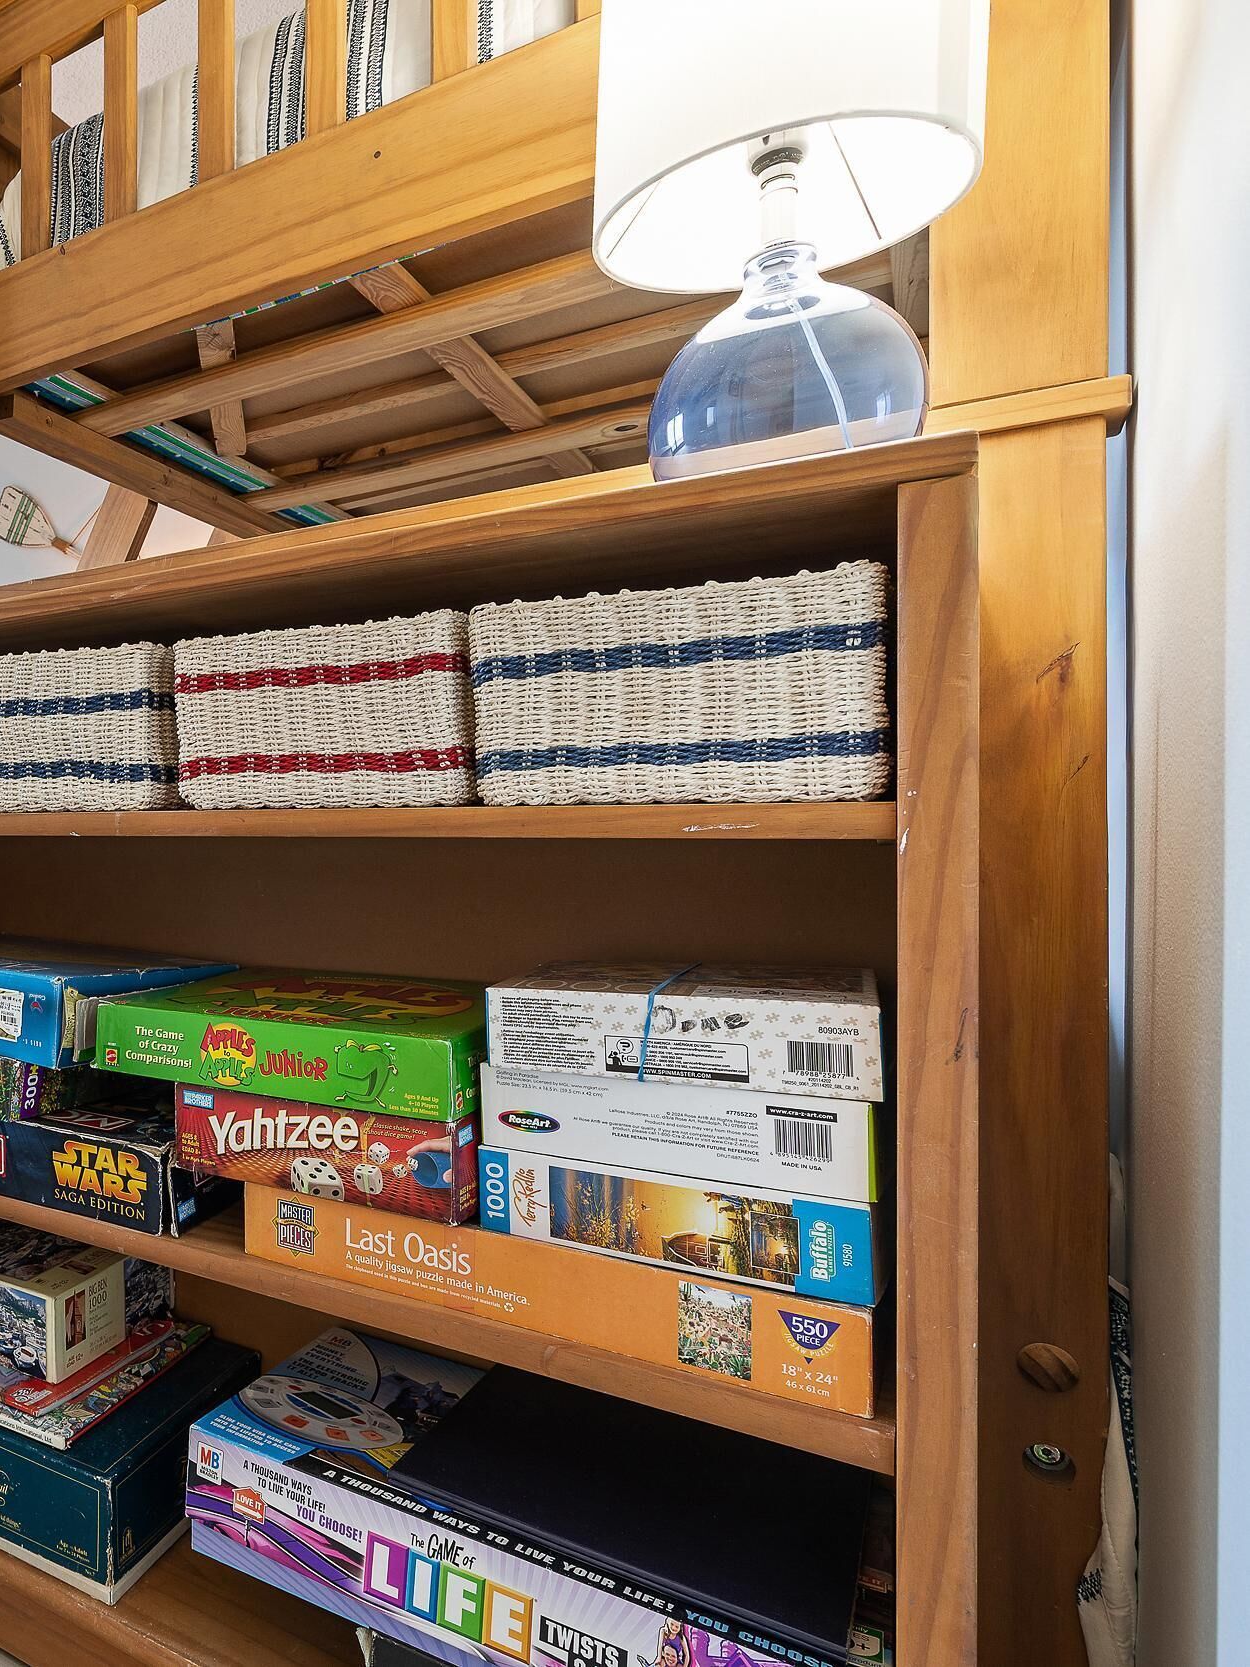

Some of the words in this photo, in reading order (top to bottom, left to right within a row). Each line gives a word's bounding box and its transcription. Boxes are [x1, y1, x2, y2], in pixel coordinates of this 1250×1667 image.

[135, 1026, 154, 1038] The
[155, 1029, 184, 1040] Game
[200, 1022, 256, 1057] APPLES
[818, 1027, 859, 1036] 80903AYB
[125, 1050, 192, 1068] Comparisons!
[139, 1040, 150, 1049] of
[151, 1043, 179, 1055] Crazy
[199, 1051, 255, 1086] APPLES
[25, 1075, 38, 1109] 300
[184, 1098, 212, 1108] BROTHERS
[192, 1092, 213, 1101] PARKER
[419, 1108, 439, 1116] Minutes
[508, 1114, 550, 1128] RoseArt
[770, 1108, 833, 1120] www.cra-z-art.com
[208, 1107, 359, 1155] Yahtzee
[397, 1133, 415, 1141] game!
[660, 1138, 695, 1147] INFORMATION
[728, 1148, 759, 1156] REFERENCE
[53, 1139, 147, 1181] STAR
[53, 1161, 147, 1203] WARS
[486, 1163, 504, 1218] 1000
[513, 1168, 541, 1201] Redlin
[54, 1188, 86, 1205] SAGA
[91, 1197, 145, 1221] EDITION
[281, 1203, 311, 1224] MASTER
[514, 1197, 547, 1227] Terry
[281, 1225, 311, 1248] PIECES
[346, 1218, 396, 1258] Last
[403, 1231, 472, 1276] Oasis
[811, 1222, 828, 1280] Buffalo
[843, 1244, 852, 1266] 91580
[89, 1283, 98, 1297] BIG
[98, 1278, 107, 1291] BEN
[346, 1251, 353, 1260] A
[355, 1254, 383, 1269] quality
[385, 1259, 414, 1275] jigsaw
[416, 1270, 444, 1283] puzzle
[447, 1277, 473, 1290] made
[475, 1283, 484, 1293] in
[487, 1287, 531, 1306] America.
[90, 1291, 107, 1309] 1000
[791, 1317, 828, 1338] 550
[797, 1334, 820, 1346] PIECE
[784, 1333, 807, 1354] JIGSAW
[811, 1343, 834, 1356] PUZZLE
[292, 1361, 327, 1376] LIFEPOD
[330, 1376, 366, 1391] TRACKS
[298, 1357, 314, 1365] THE
[316, 1365, 369, 1386] ELECTRONIC
[781, 1364, 802, 1376] 18"
[805, 1372, 812, 1380] x
[816, 1372, 838, 1385] 24"
[786, 1380, 797, 1388] 46
[210, 1421, 225, 1430] YOUR
[226, 1429, 264, 1446] INFORMATION
[219, 1414, 236, 1423] SLIDE
[237, 1422, 251, 1430] YOUR
[252, 1429, 266, 1437] VISA
[267, 1435, 283, 1443] GAME
[284, 1442, 301, 1451] CARD
[240, 1429, 263, 1440] LIFEPOD
[272, 1442, 297, 1454] ACCESS
[200, 1447, 220, 1469] MB
[201, 1465, 218, 1476] MILTON
[199, 1469, 218, 1481] BRADLEY
[243, 1460, 249, 1469] A
[250, 1463, 289, 1486] THOUSAND
[291, 1479, 313, 1495] WAYS
[236, 1493, 253, 1507] LOVE
[254, 1499, 262, 1510] IT
[258, 1477, 267, 1488] TO
[268, 1481, 284, 1496] LIVE
[286, 1488, 305, 1506] YOUR
[307, 1498, 326, 1513] LIFE!
[297, 1505, 315, 1522] YOU
[319, 1515, 362, 1543] CHOOSE!
[323, 1469, 336, 1478] A
[340, 1475, 427, 1514] THOUSAND
[432, 1511, 481, 1534] WAYS
[486, 1531, 510, 1546] TO
[514, 1543, 556, 1565] LIVE
[562, 1561, 617, 1590] YOUR
[623, 1586, 675, 1613] LIFE!
[410, 1532, 425, 1549] The
[427, 1533, 464, 1568] GAME
[462, 1556, 477, 1569] of
[370, 1540, 525, 1653] LIFE
[684, 1608, 730, 1634] YOU
[546, 1620, 619, 1667] TWISTS
